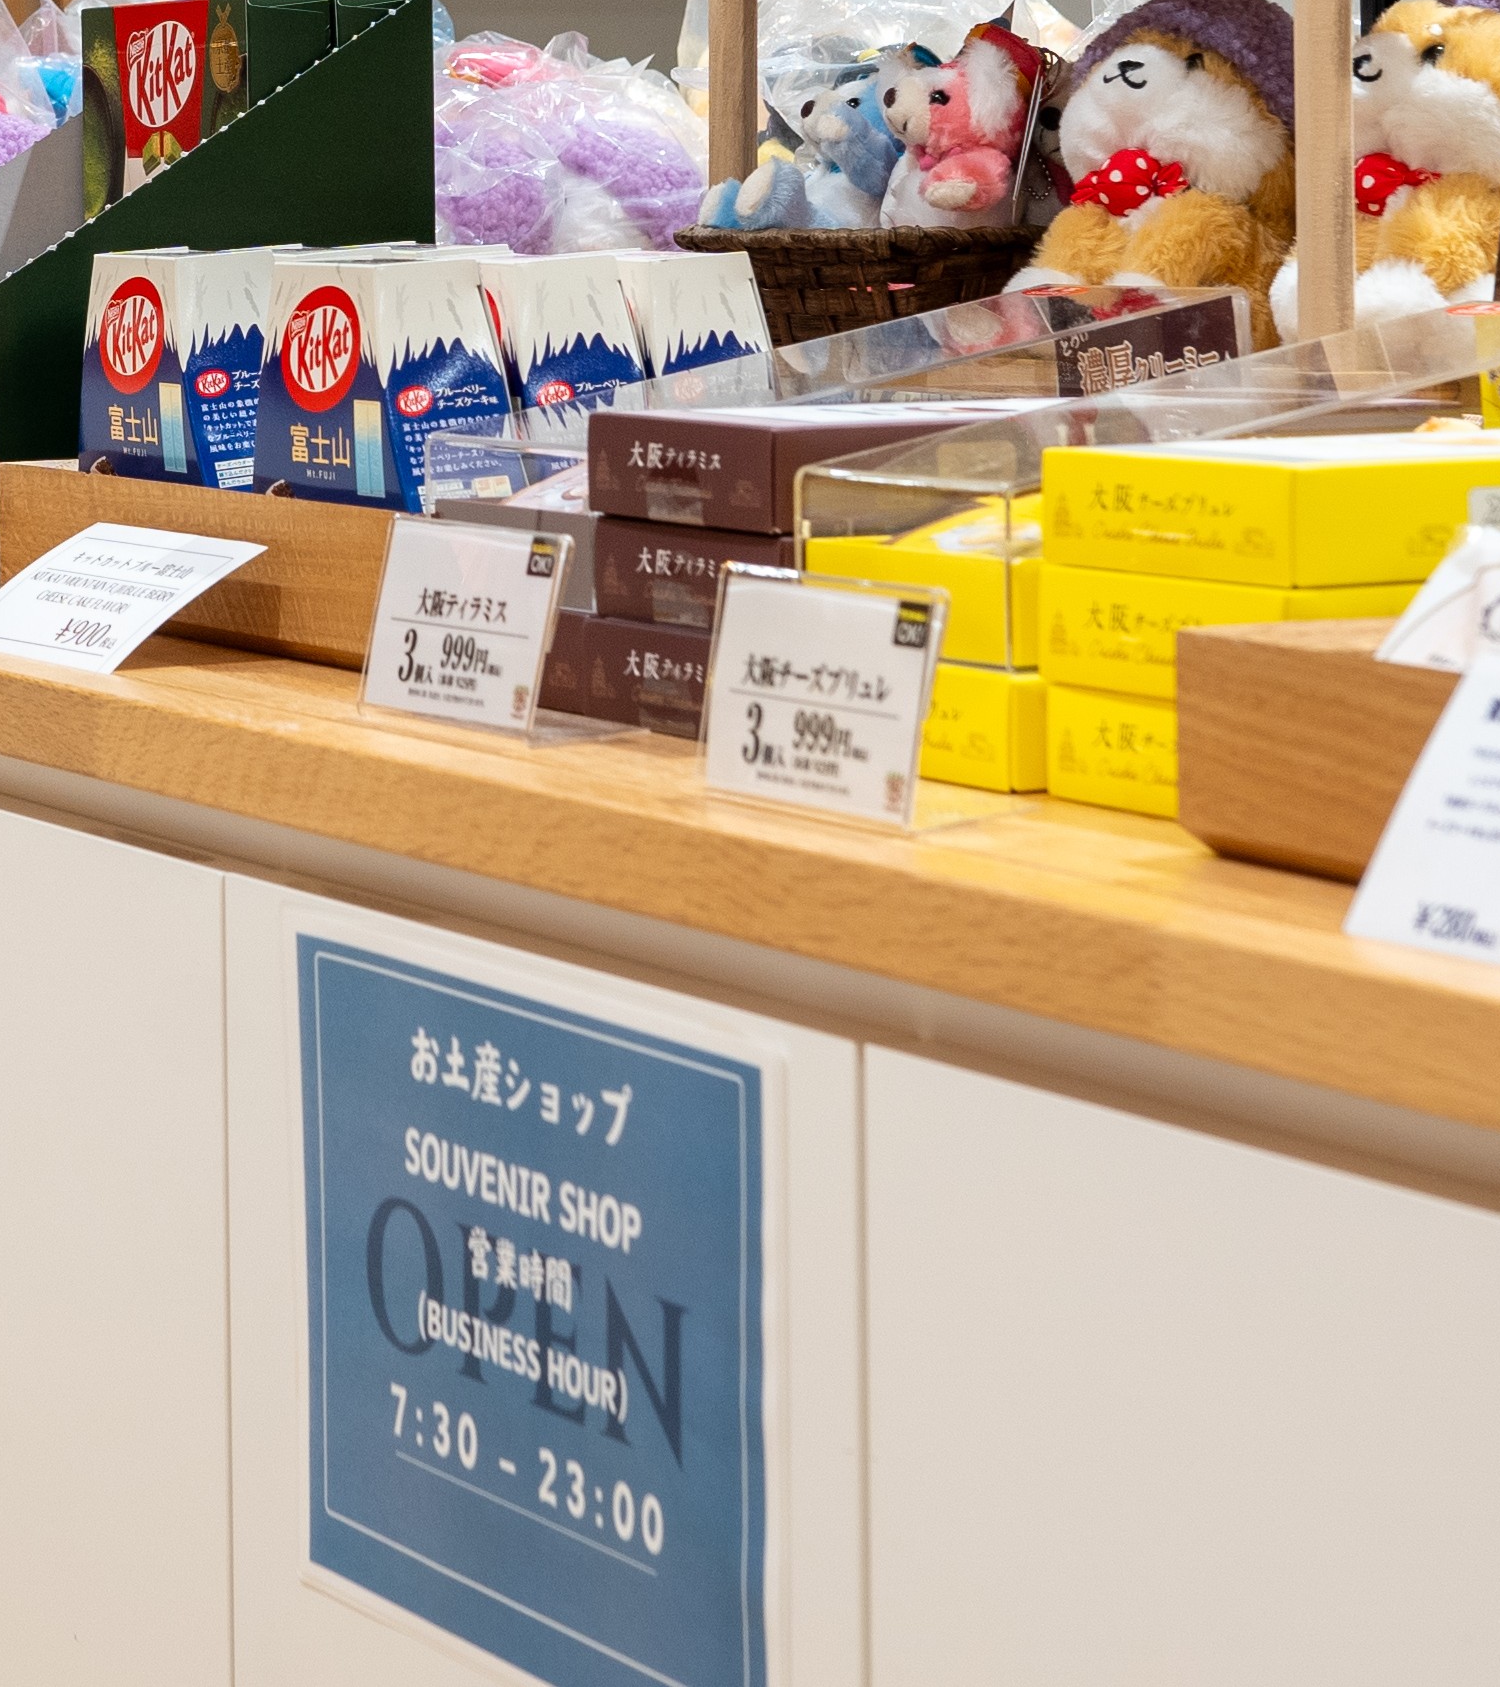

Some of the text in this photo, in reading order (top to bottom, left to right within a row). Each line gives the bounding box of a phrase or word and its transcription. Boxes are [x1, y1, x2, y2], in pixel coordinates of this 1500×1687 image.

[136, 23, 192, 125] KitKat
[112, 297, 155, 373] KitKat
[298, 308, 350, 390] KitKat
[108, 404, 158, 446] 富士山
[435, 384, 486, 398] ブルーベリー
[438, 395, 499, 410] チーズケーキ味
[290, 423, 350, 468] 富士山
[627, 441, 722, 471] 大阪ティラミス
[56, 618, 111, 648] ¥900
[417, 587, 508, 624] 大阪ティラミス
[410, 1027, 631, 1146] お土産ショップ
[404, 1126, 642, 1253] SOUVENIR SHOP
[467, 1227, 572, 1312] 営業時間
[366, 1196, 689, 1470] OPEN
[417, 1291, 627, 1424] (BUSINESS HOUR)
[391, 1384, 663, 1556] 7:30 23:00
